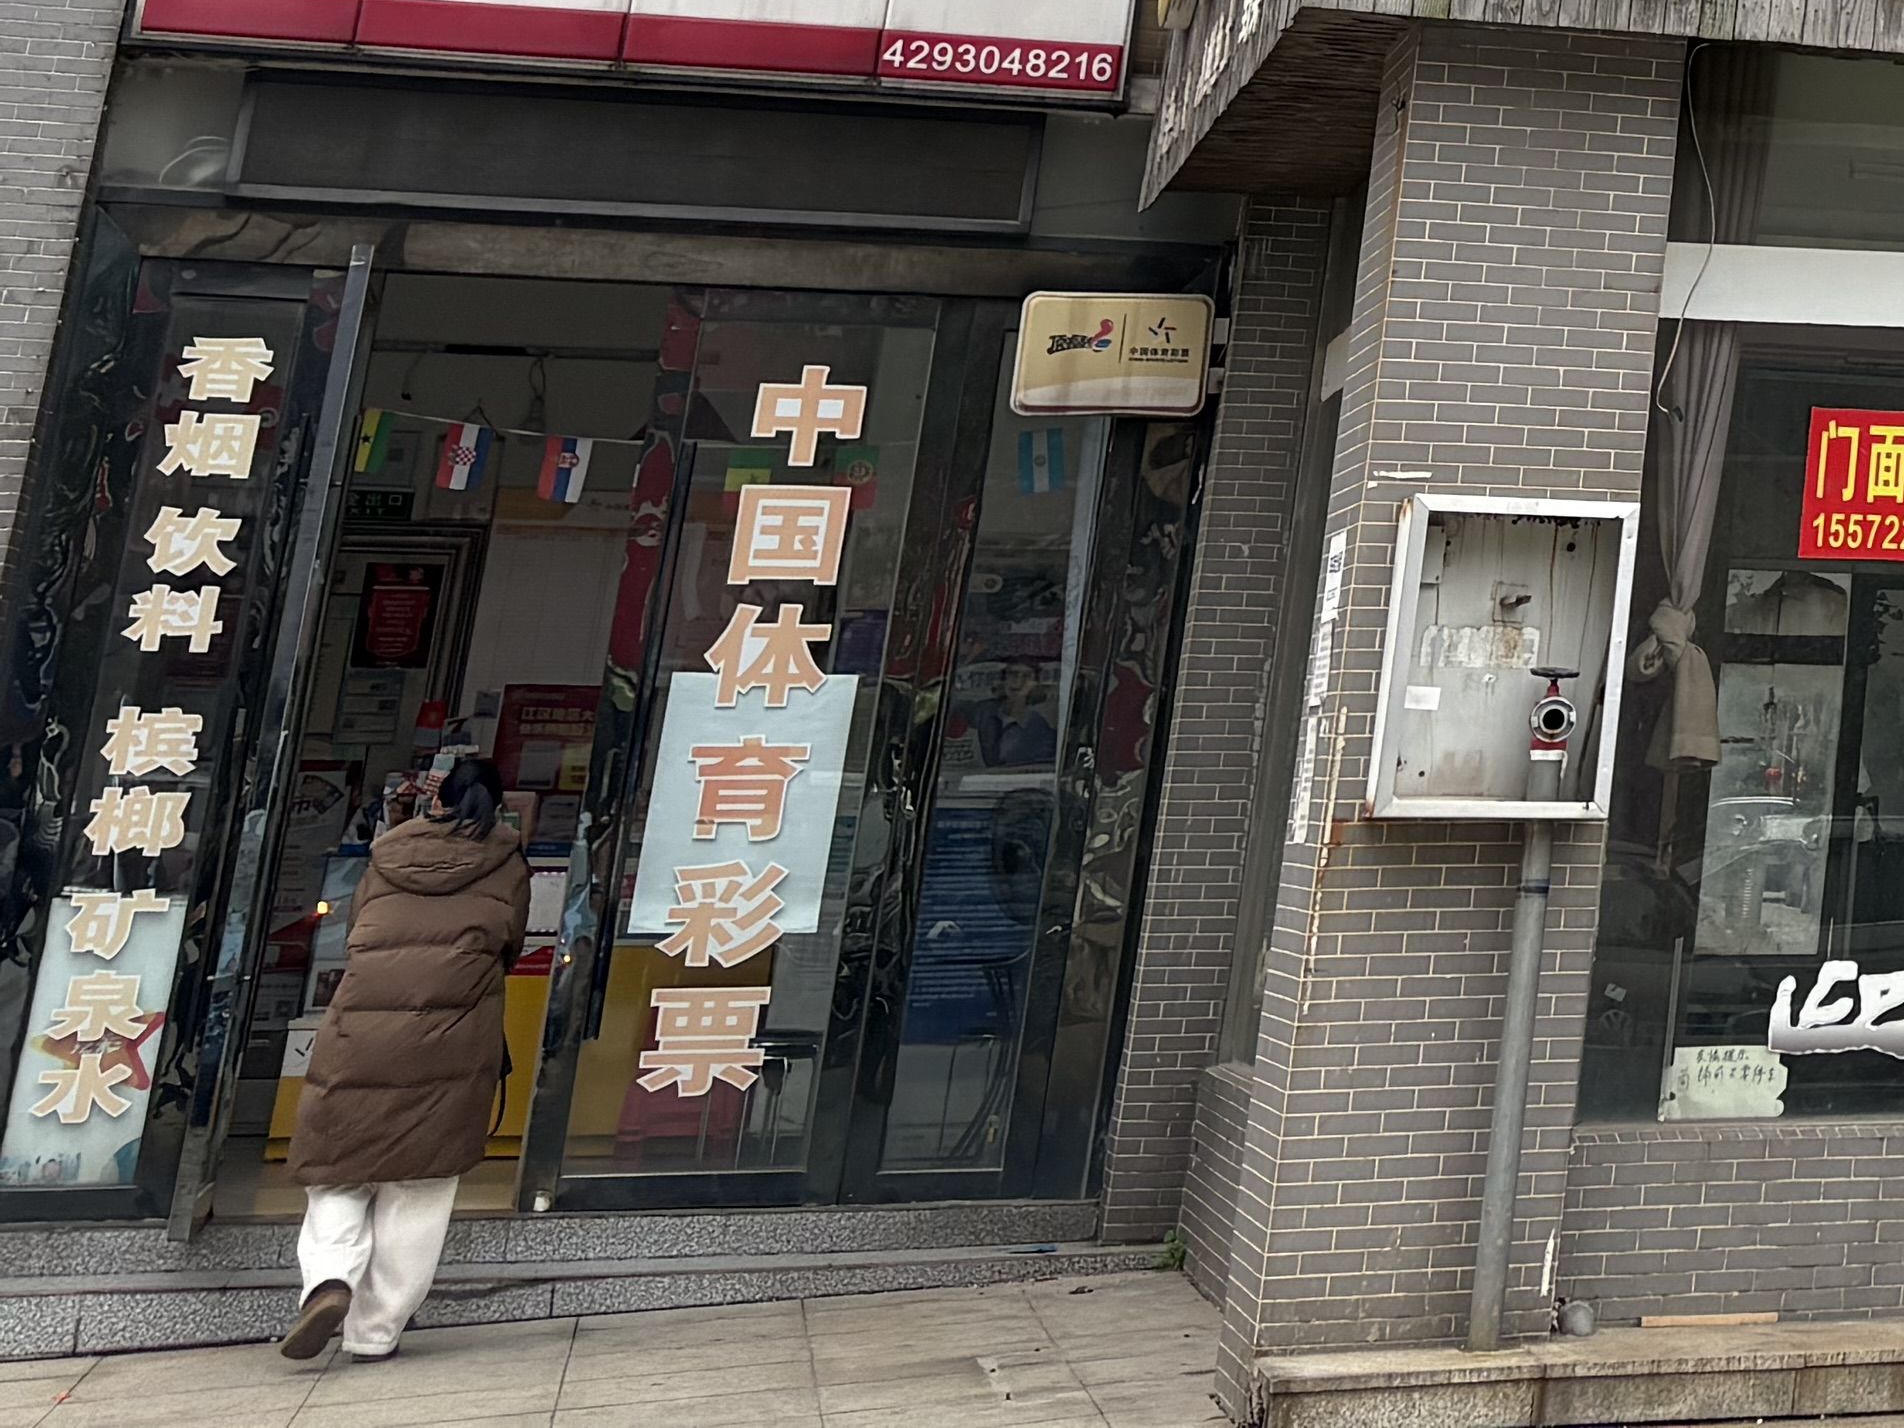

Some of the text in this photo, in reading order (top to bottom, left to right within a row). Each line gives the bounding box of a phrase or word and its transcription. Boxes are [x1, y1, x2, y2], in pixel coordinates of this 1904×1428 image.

[882, 37, 1114, 82] 4293048216
[30, 337, 273, 1124] 香烟 饮料 槟榔 矿泉水
[638, 364, 868, 1097] 中国体育彩票
